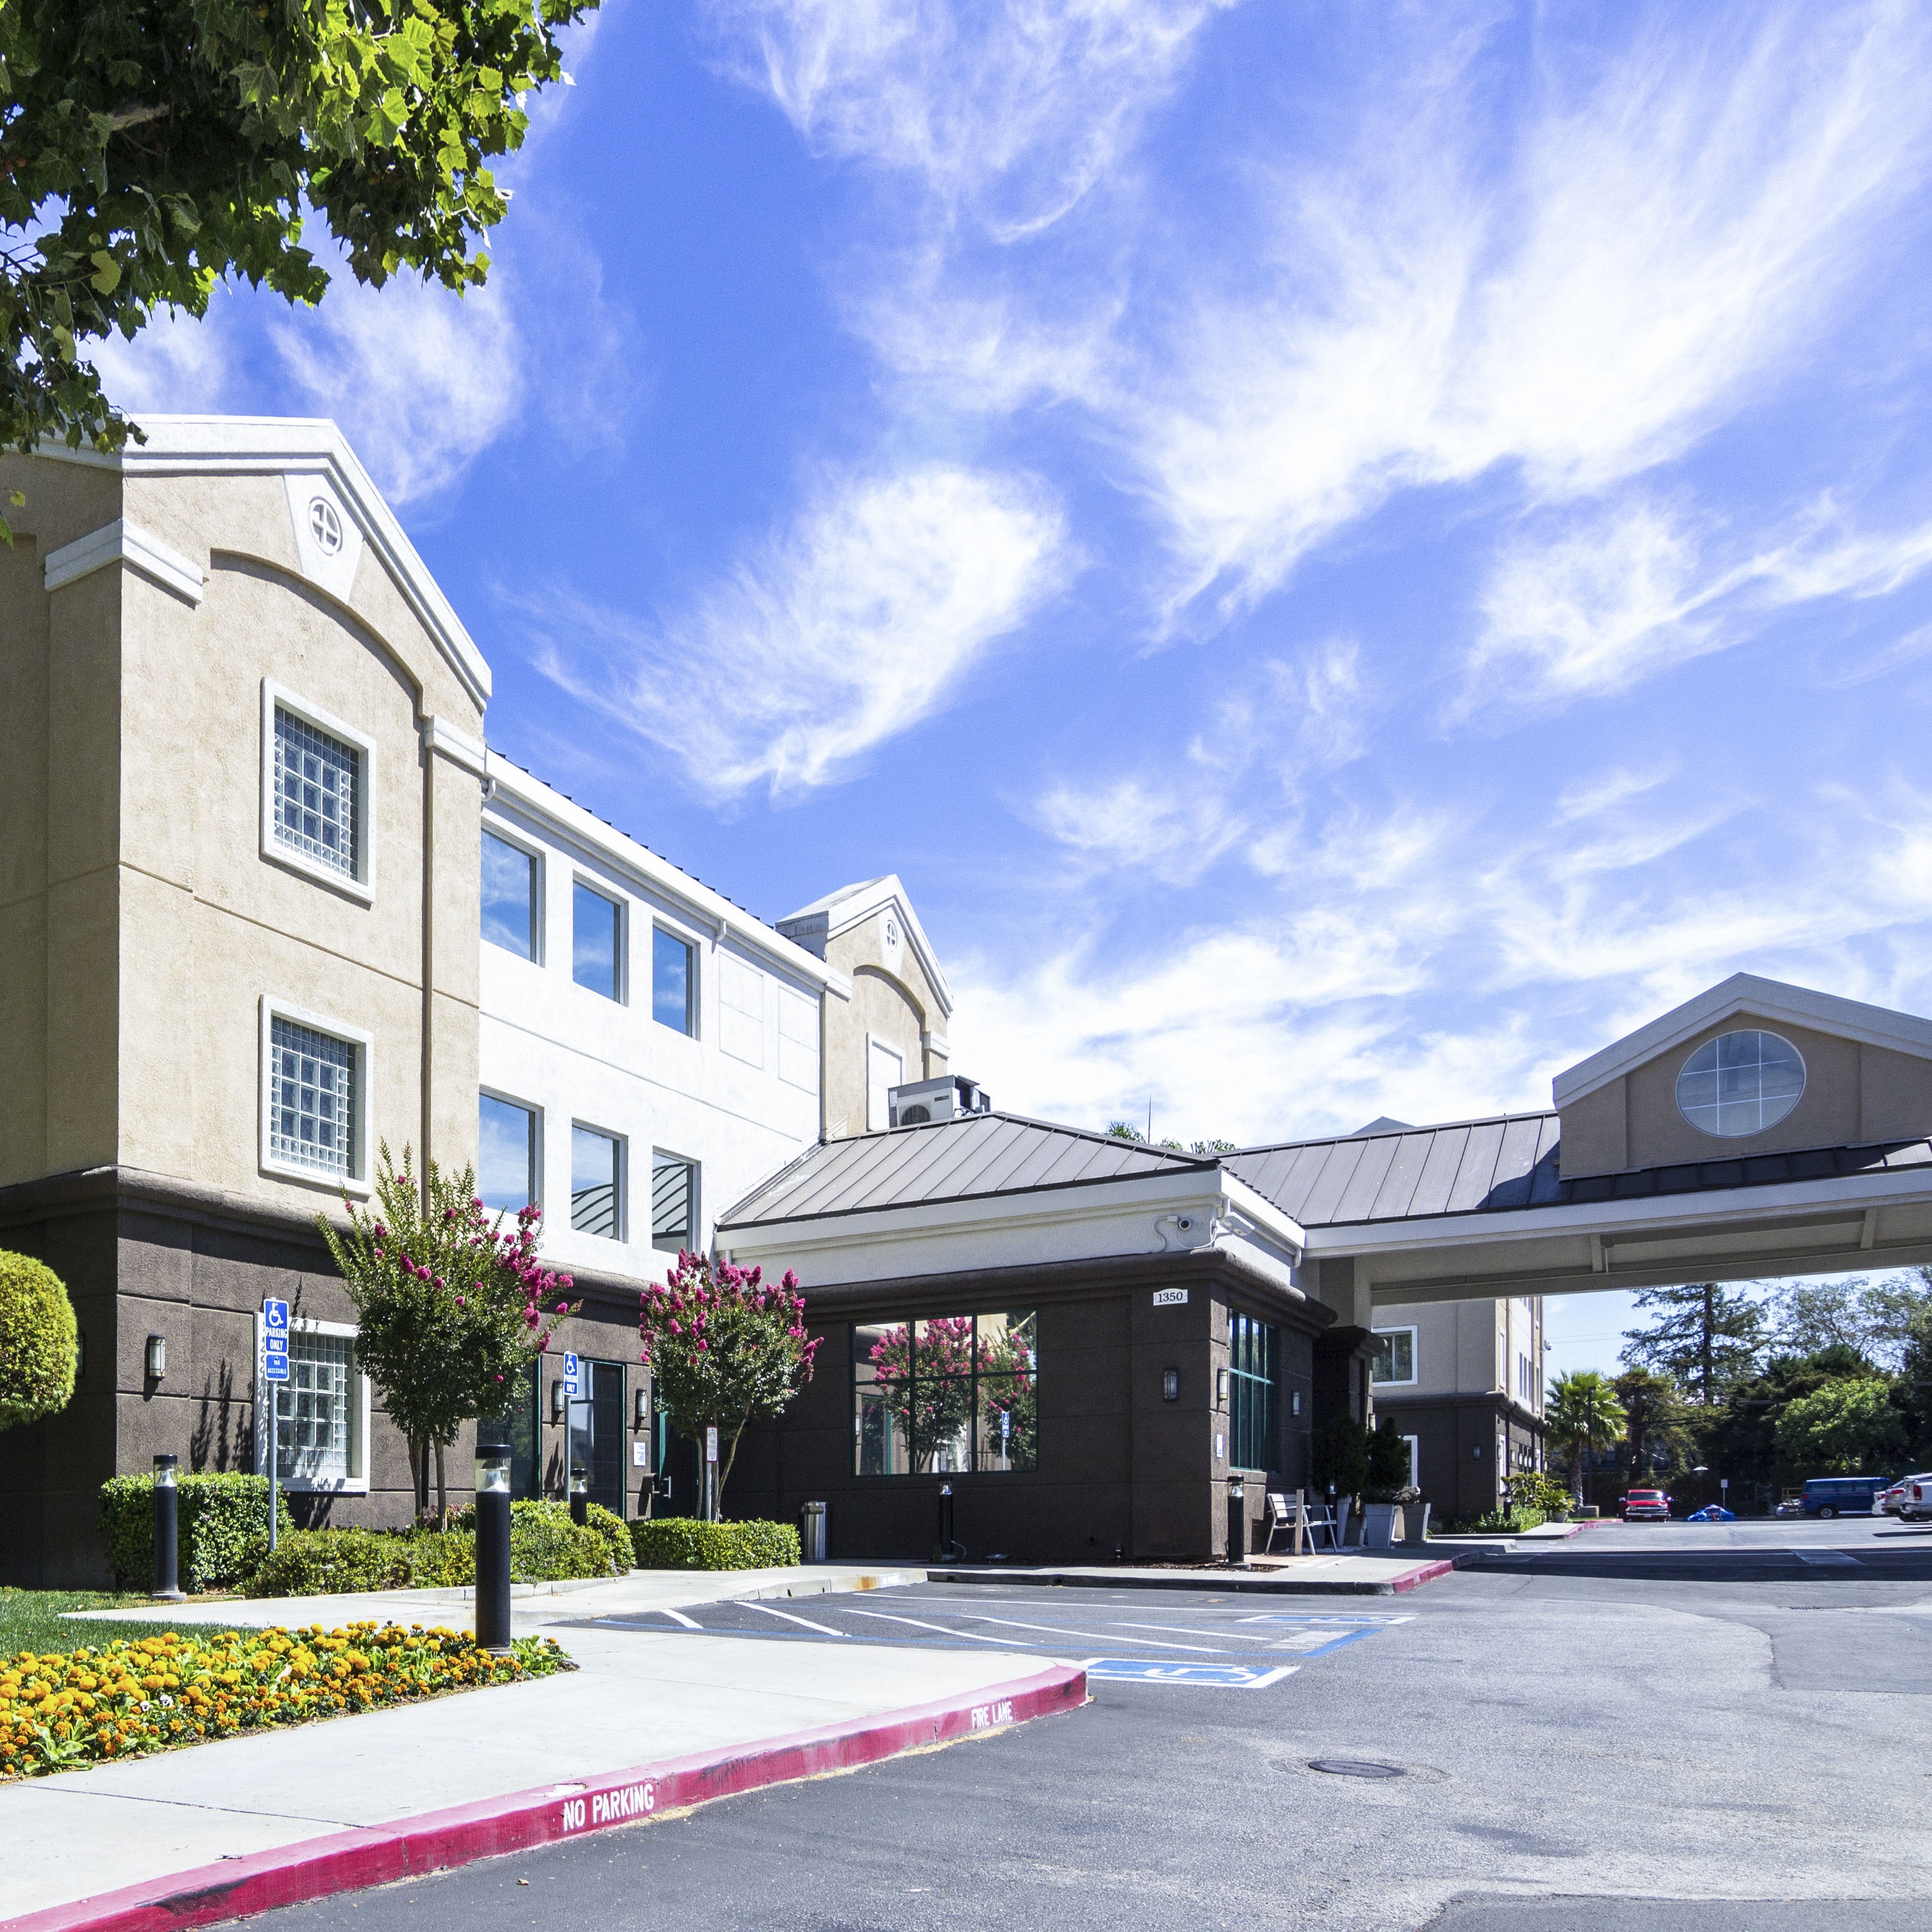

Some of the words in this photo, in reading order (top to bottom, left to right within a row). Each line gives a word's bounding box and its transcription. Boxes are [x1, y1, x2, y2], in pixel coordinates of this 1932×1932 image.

[1159, 1292, 1183, 1302] 1350
[266, 1327, 287, 1339] PARKING
[270, 1339, 283, 1350] ONLY
[971, 1706, 990, 1730] FIRE
[992, 1701, 1013, 1724] LANE
[564, 1799, 585, 1832] NO
[592, 1783, 654, 1824] PARKING
